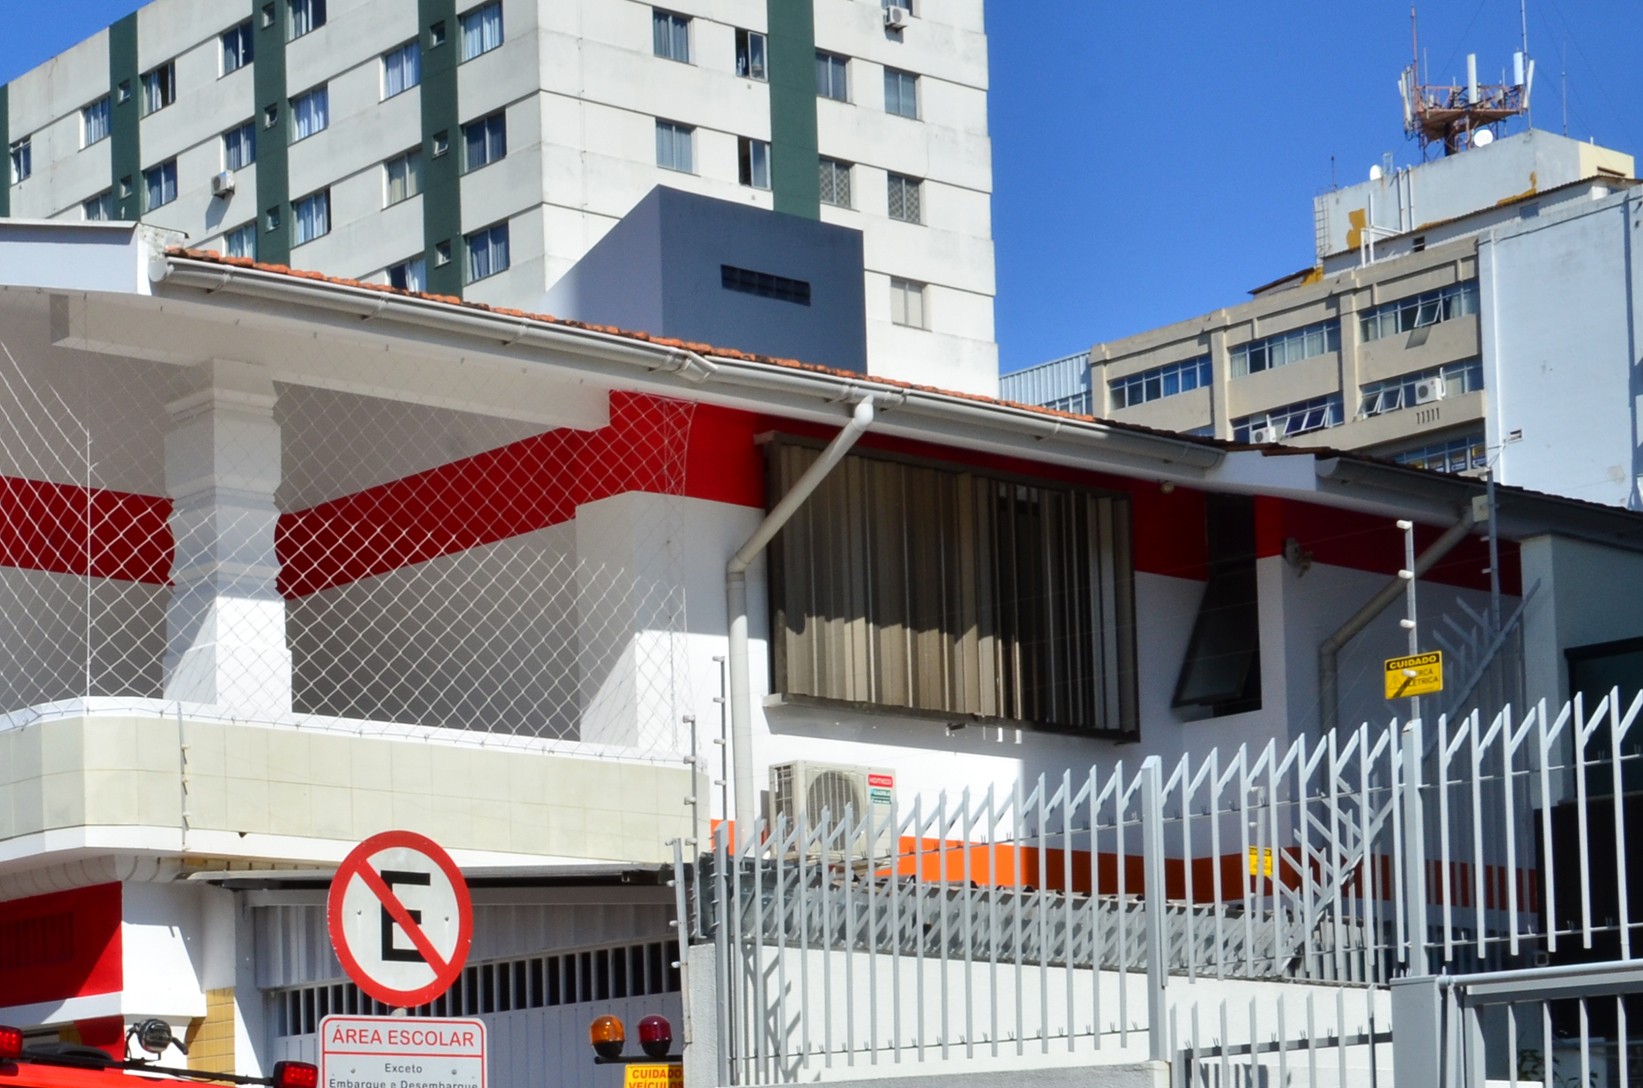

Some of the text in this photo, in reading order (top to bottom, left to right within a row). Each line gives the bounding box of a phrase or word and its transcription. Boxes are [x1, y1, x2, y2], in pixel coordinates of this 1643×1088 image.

[1389, 655, 1437, 670] CUIDADO
[380, 870, 431, 963] E
[332, 1025, 474, 1047] ÁREA ESCOLAR
[384, 1063, 422, 1074] Exceto
[632, 1069, 682, 1079] CUIDADO
